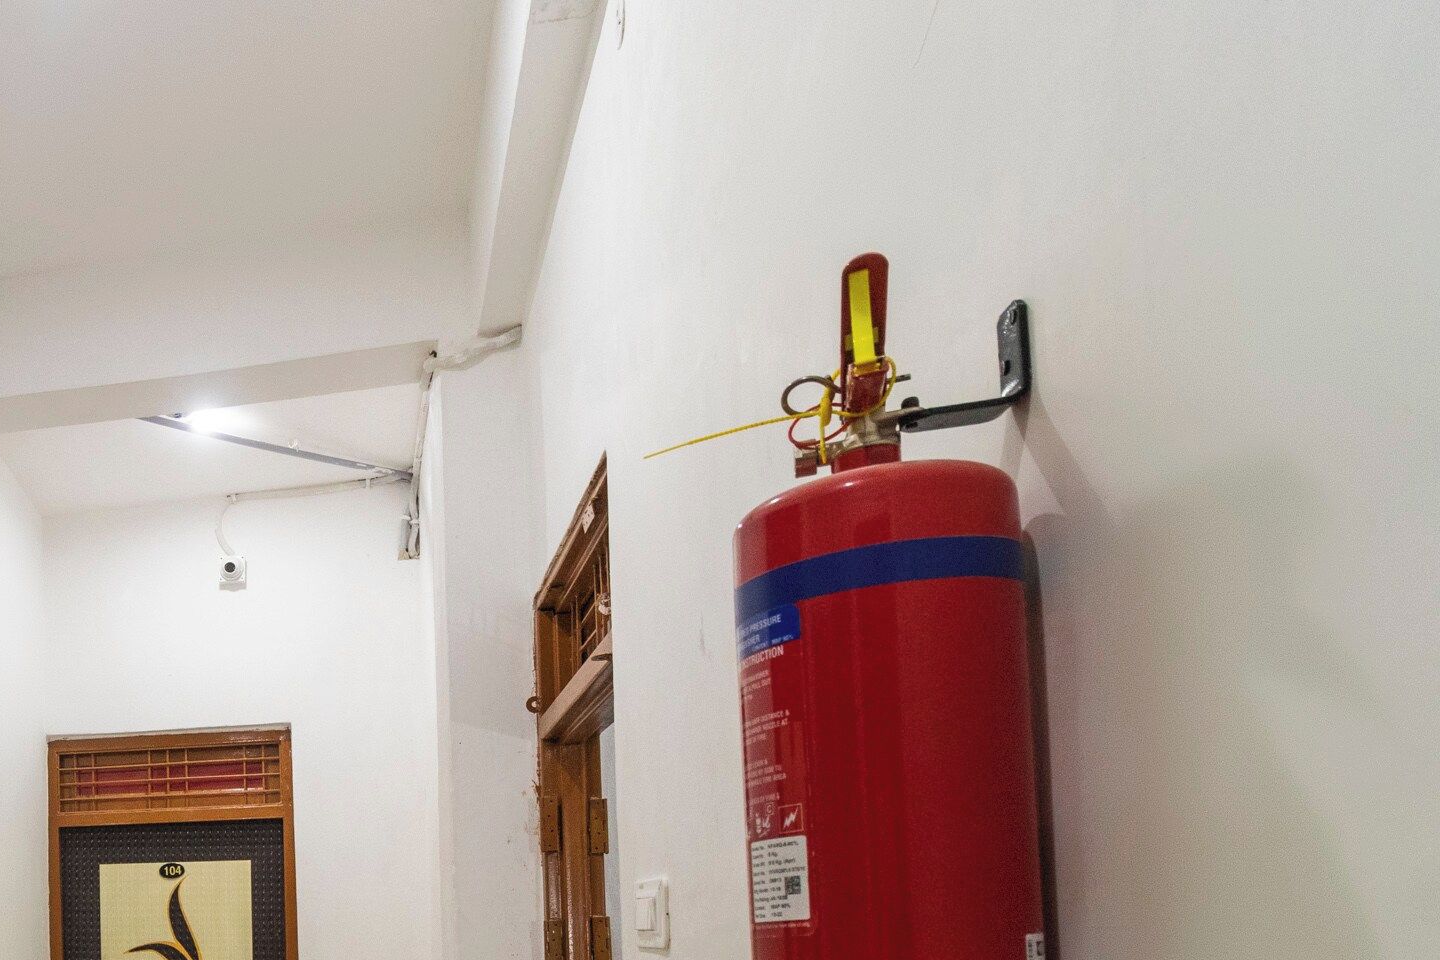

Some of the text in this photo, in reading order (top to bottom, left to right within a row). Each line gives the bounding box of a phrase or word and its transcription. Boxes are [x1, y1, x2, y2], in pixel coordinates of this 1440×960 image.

[750, 613, 782, 633] PRESSURE
[740, 645, 784, 668] NSTRUCTION
[164, 865, 181, 876] 104
